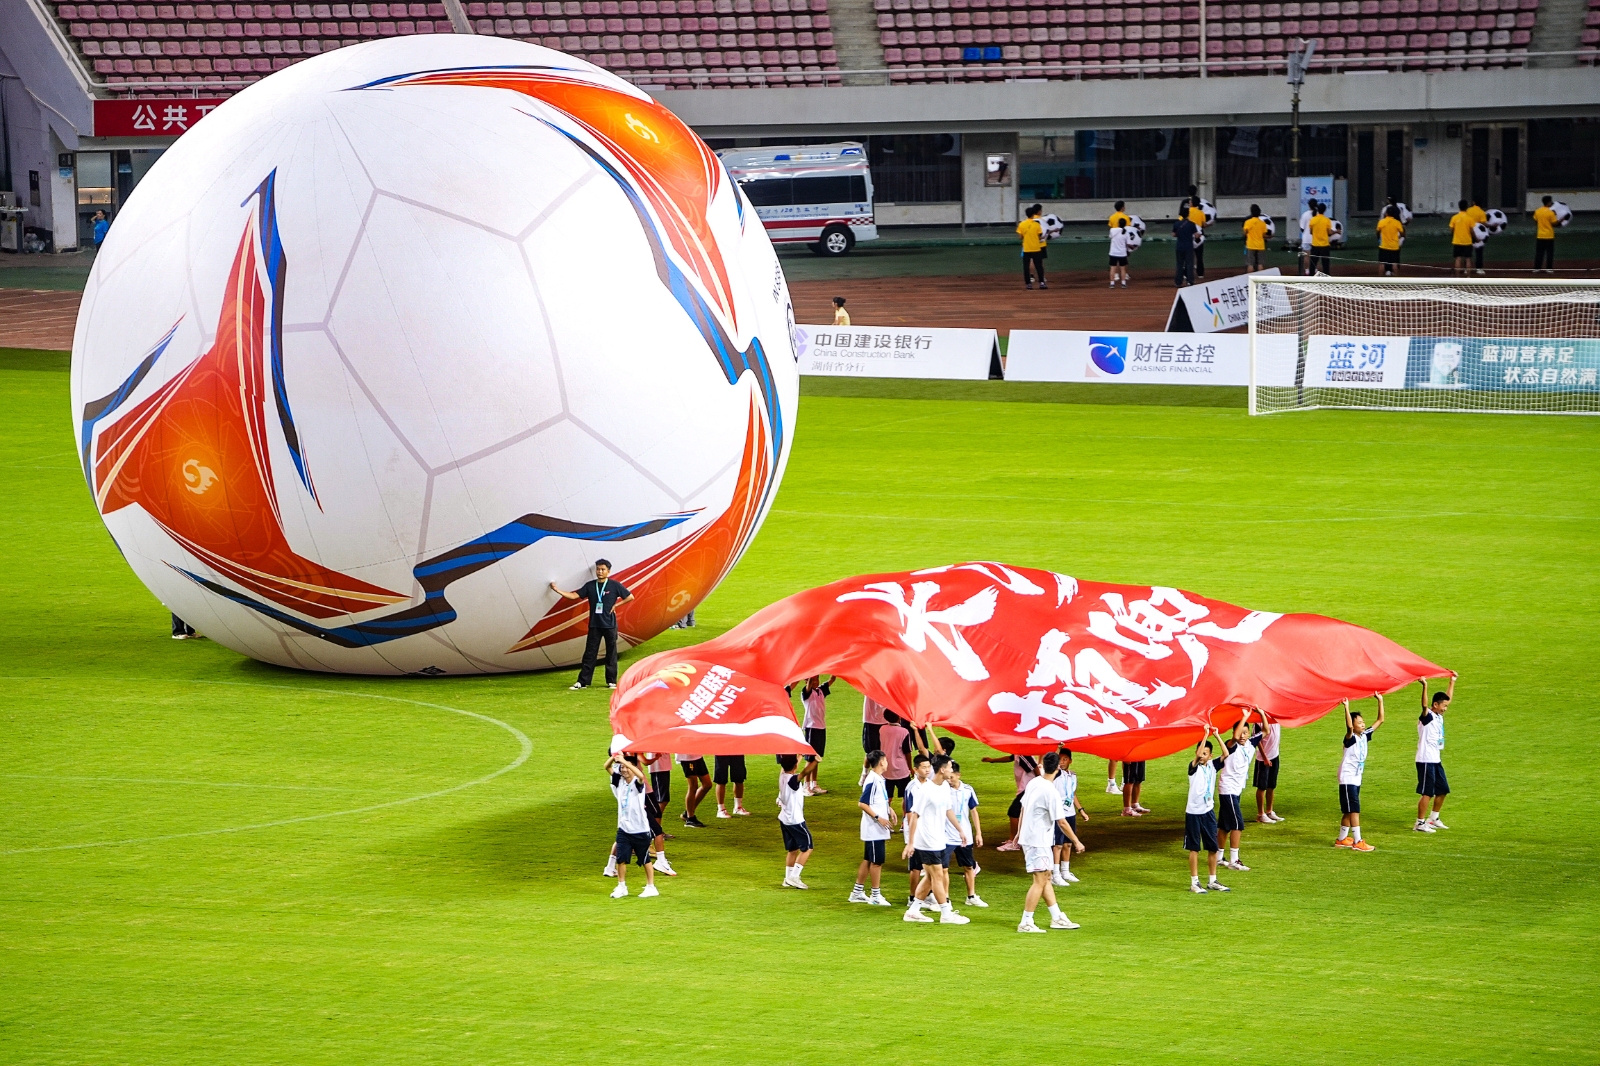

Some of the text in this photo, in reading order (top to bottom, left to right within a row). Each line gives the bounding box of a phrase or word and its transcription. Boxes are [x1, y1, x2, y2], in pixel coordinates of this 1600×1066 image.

[815, 333, 933, 350] 中国建设银行
[813, 348, 915, 359] China Construction Bank
[1132, 343, 1216, 364] 财信金控
[1326, 342, 1387, 369] 蓝河
[1481, 344, 1574, 364] 蓝河营养足
[811, 361, 866, 372] 湖南省分行
[1131, 365, 1213, 374] CHASING FINANCIAL
[1503, 366, 1597, 385] 状态自然满
[704, 686, 747, 721] HNFL
